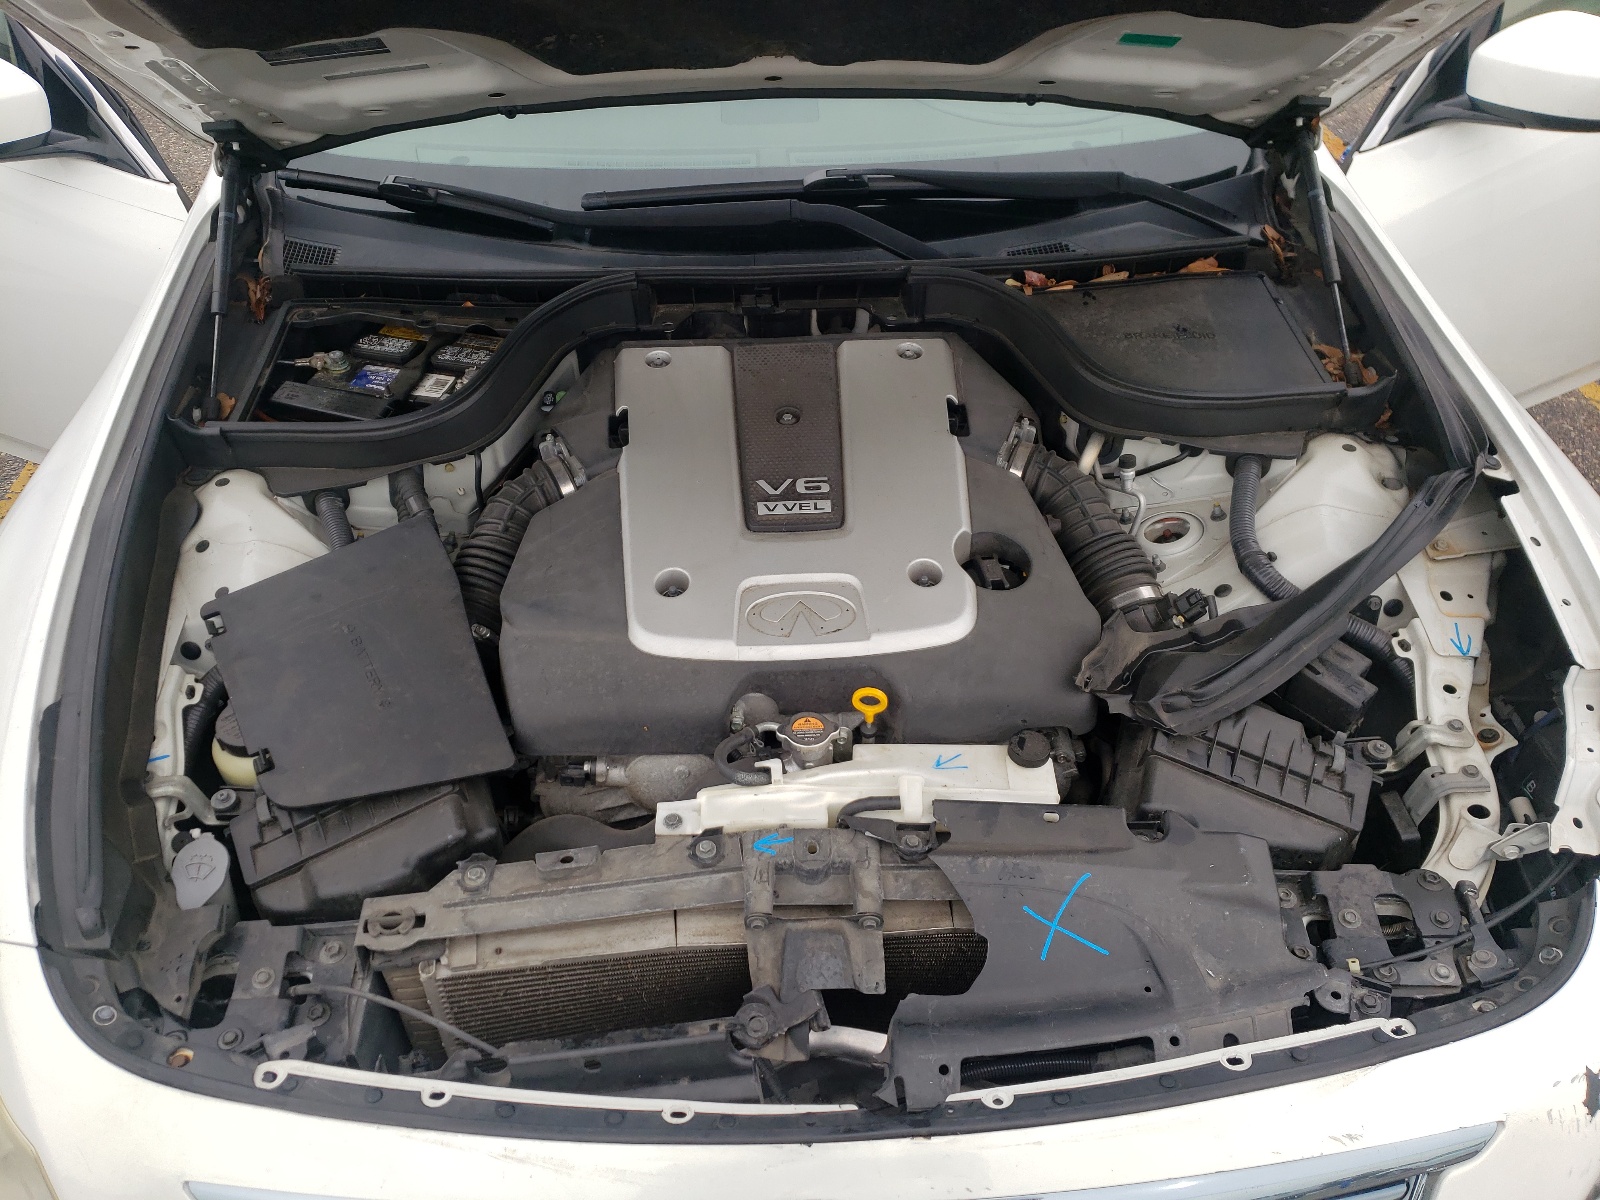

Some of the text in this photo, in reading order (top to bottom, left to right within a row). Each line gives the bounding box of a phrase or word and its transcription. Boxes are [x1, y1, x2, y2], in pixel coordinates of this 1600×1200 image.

[1122, 331, 1171, 340] BRAKE
[755, 476, 831, 495] V6
[762, 501, 826, 512] VVEL
